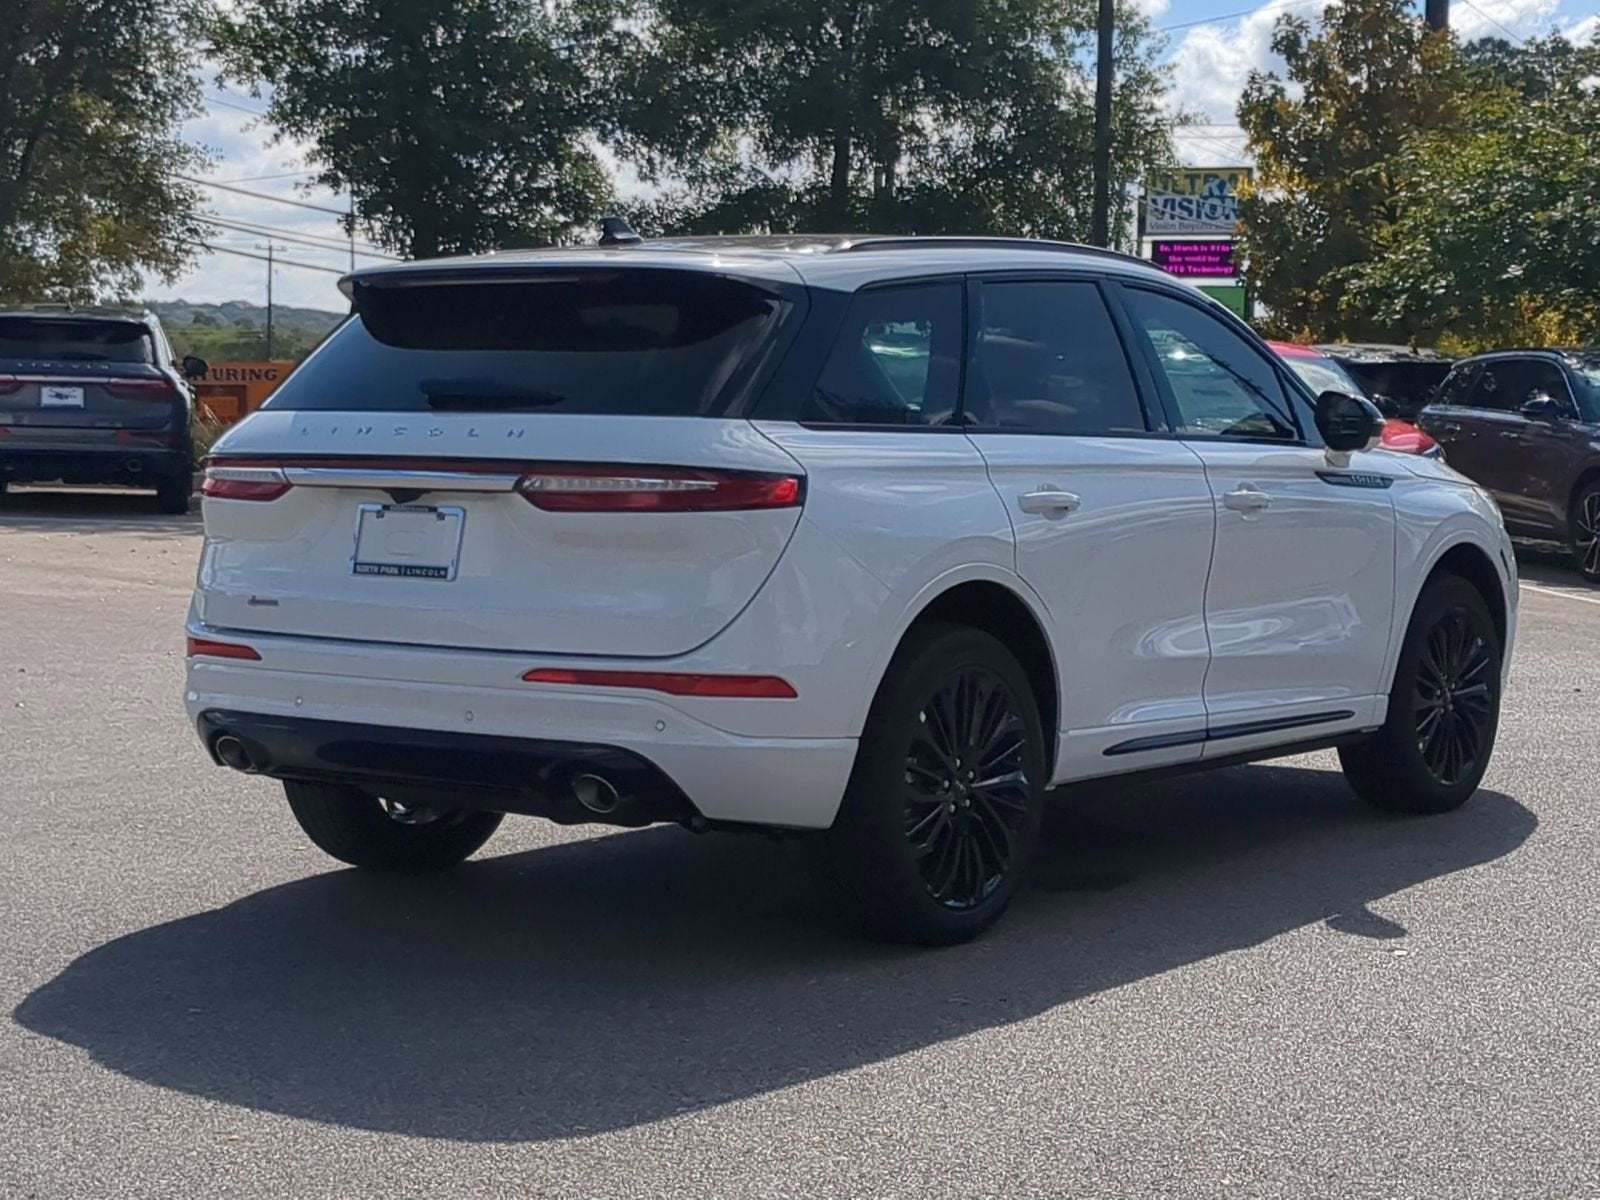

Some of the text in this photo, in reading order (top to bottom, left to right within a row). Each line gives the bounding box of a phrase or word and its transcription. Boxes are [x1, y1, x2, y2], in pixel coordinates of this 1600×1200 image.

[1151, 197, 1238, 220] VISION
[302, 427, 525, 438] LINCOLN
[407, 567, 446, 577] LINCOLN
